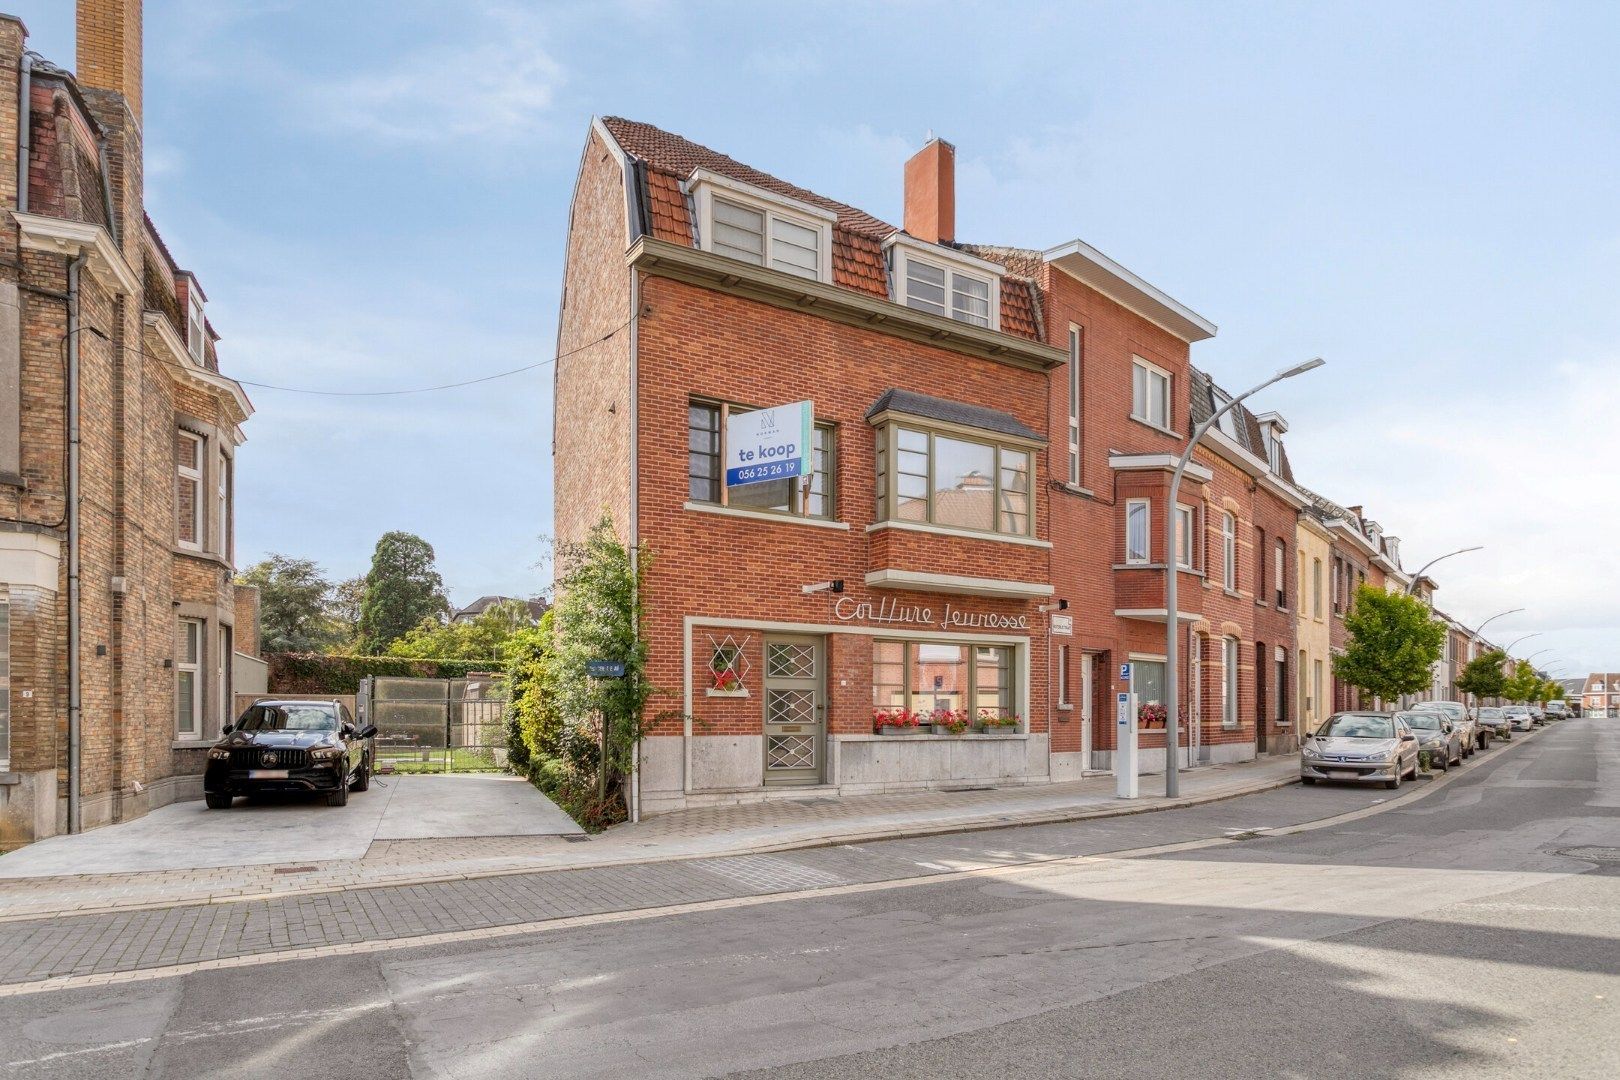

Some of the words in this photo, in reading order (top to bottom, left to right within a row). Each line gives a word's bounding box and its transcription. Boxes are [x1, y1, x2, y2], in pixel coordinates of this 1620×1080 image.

[739, 449, 754, 462] te
[758, 444, 796, 458] koop
[738, 468, 754, 480] 056
[757, 466, 768, 476] 25
[770, 464, 782, 475] 26
[785, 462, 795, 472] 19
[835, 597, 935, 624] Coiffure
[940, 603, 1031, 630] Jeunesse
